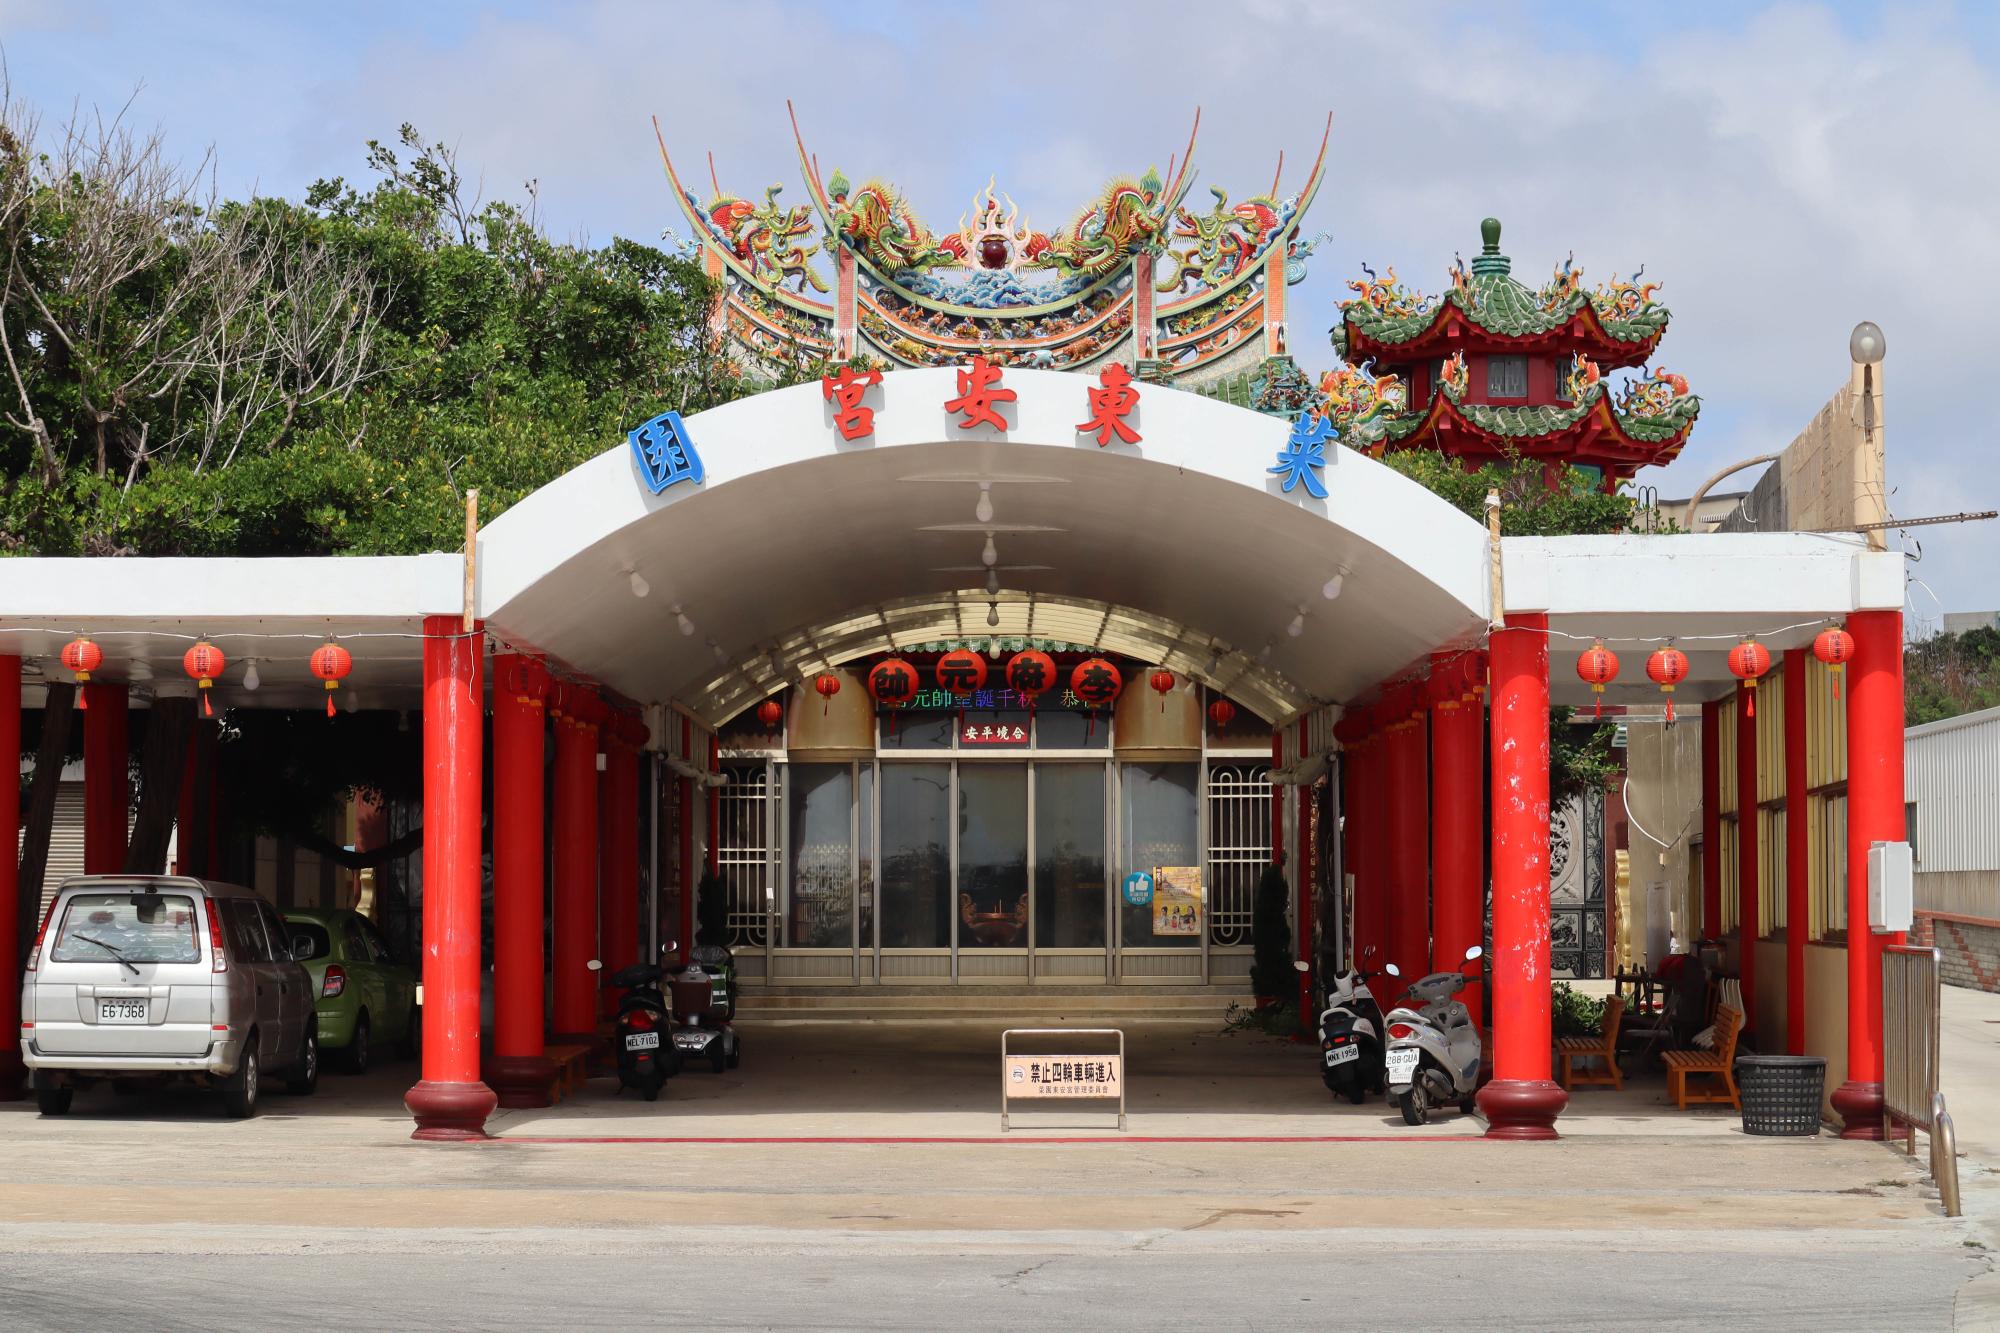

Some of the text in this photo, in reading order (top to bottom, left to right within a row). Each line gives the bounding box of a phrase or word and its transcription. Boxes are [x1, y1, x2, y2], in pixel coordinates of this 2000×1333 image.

[1030, 1062, 1115, 1083] 禁止四輪車輛進入
